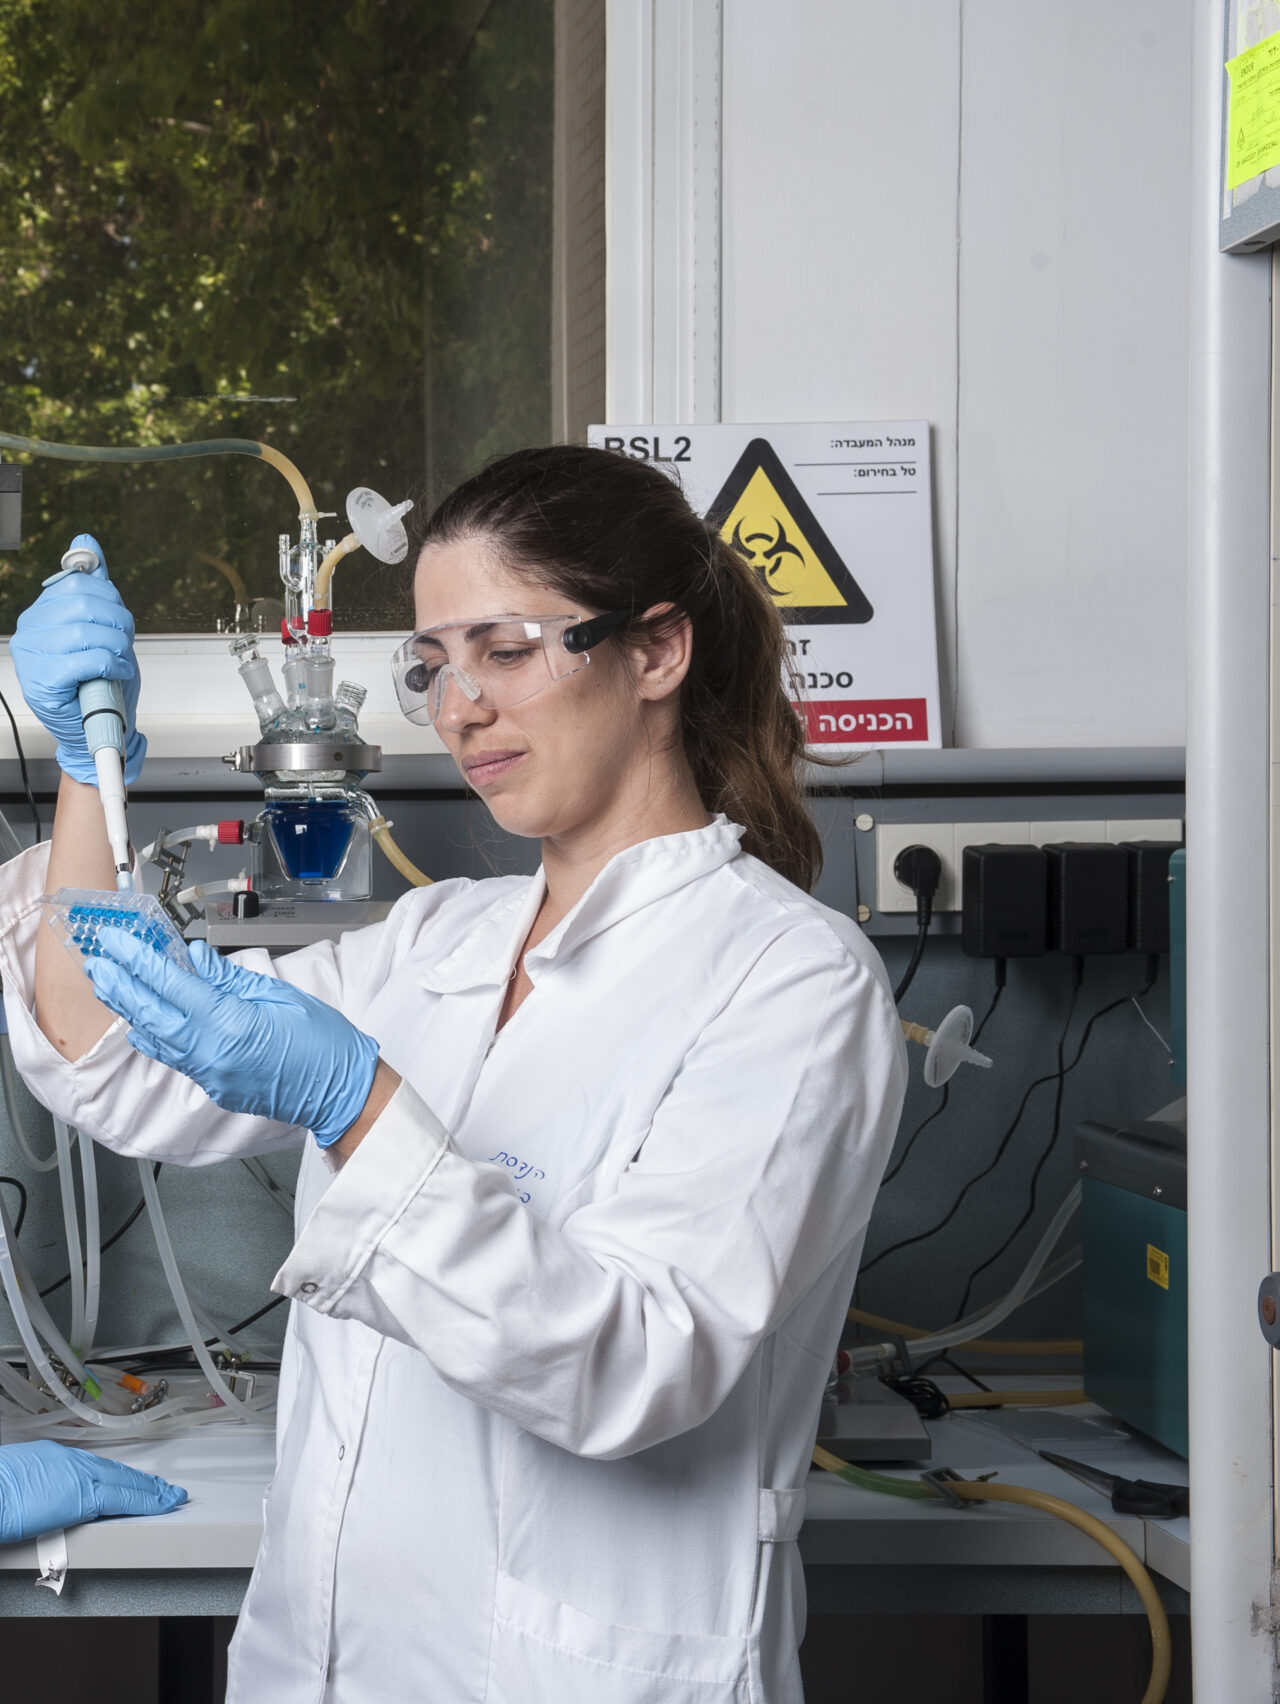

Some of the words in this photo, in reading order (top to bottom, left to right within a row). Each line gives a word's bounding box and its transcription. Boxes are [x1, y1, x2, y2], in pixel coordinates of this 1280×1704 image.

[830, 439, 882, 448] המעבדה:
[886, 436, 915, 447] מנהל
[854, 468, 896, 477] בחירום:
[901, 466, 916, 476] טל
[789, 672, 853, 689] סכנה
[820, 713, 913, 732] הכניסה
[488, 1151, 545, 1180] הנדסת
